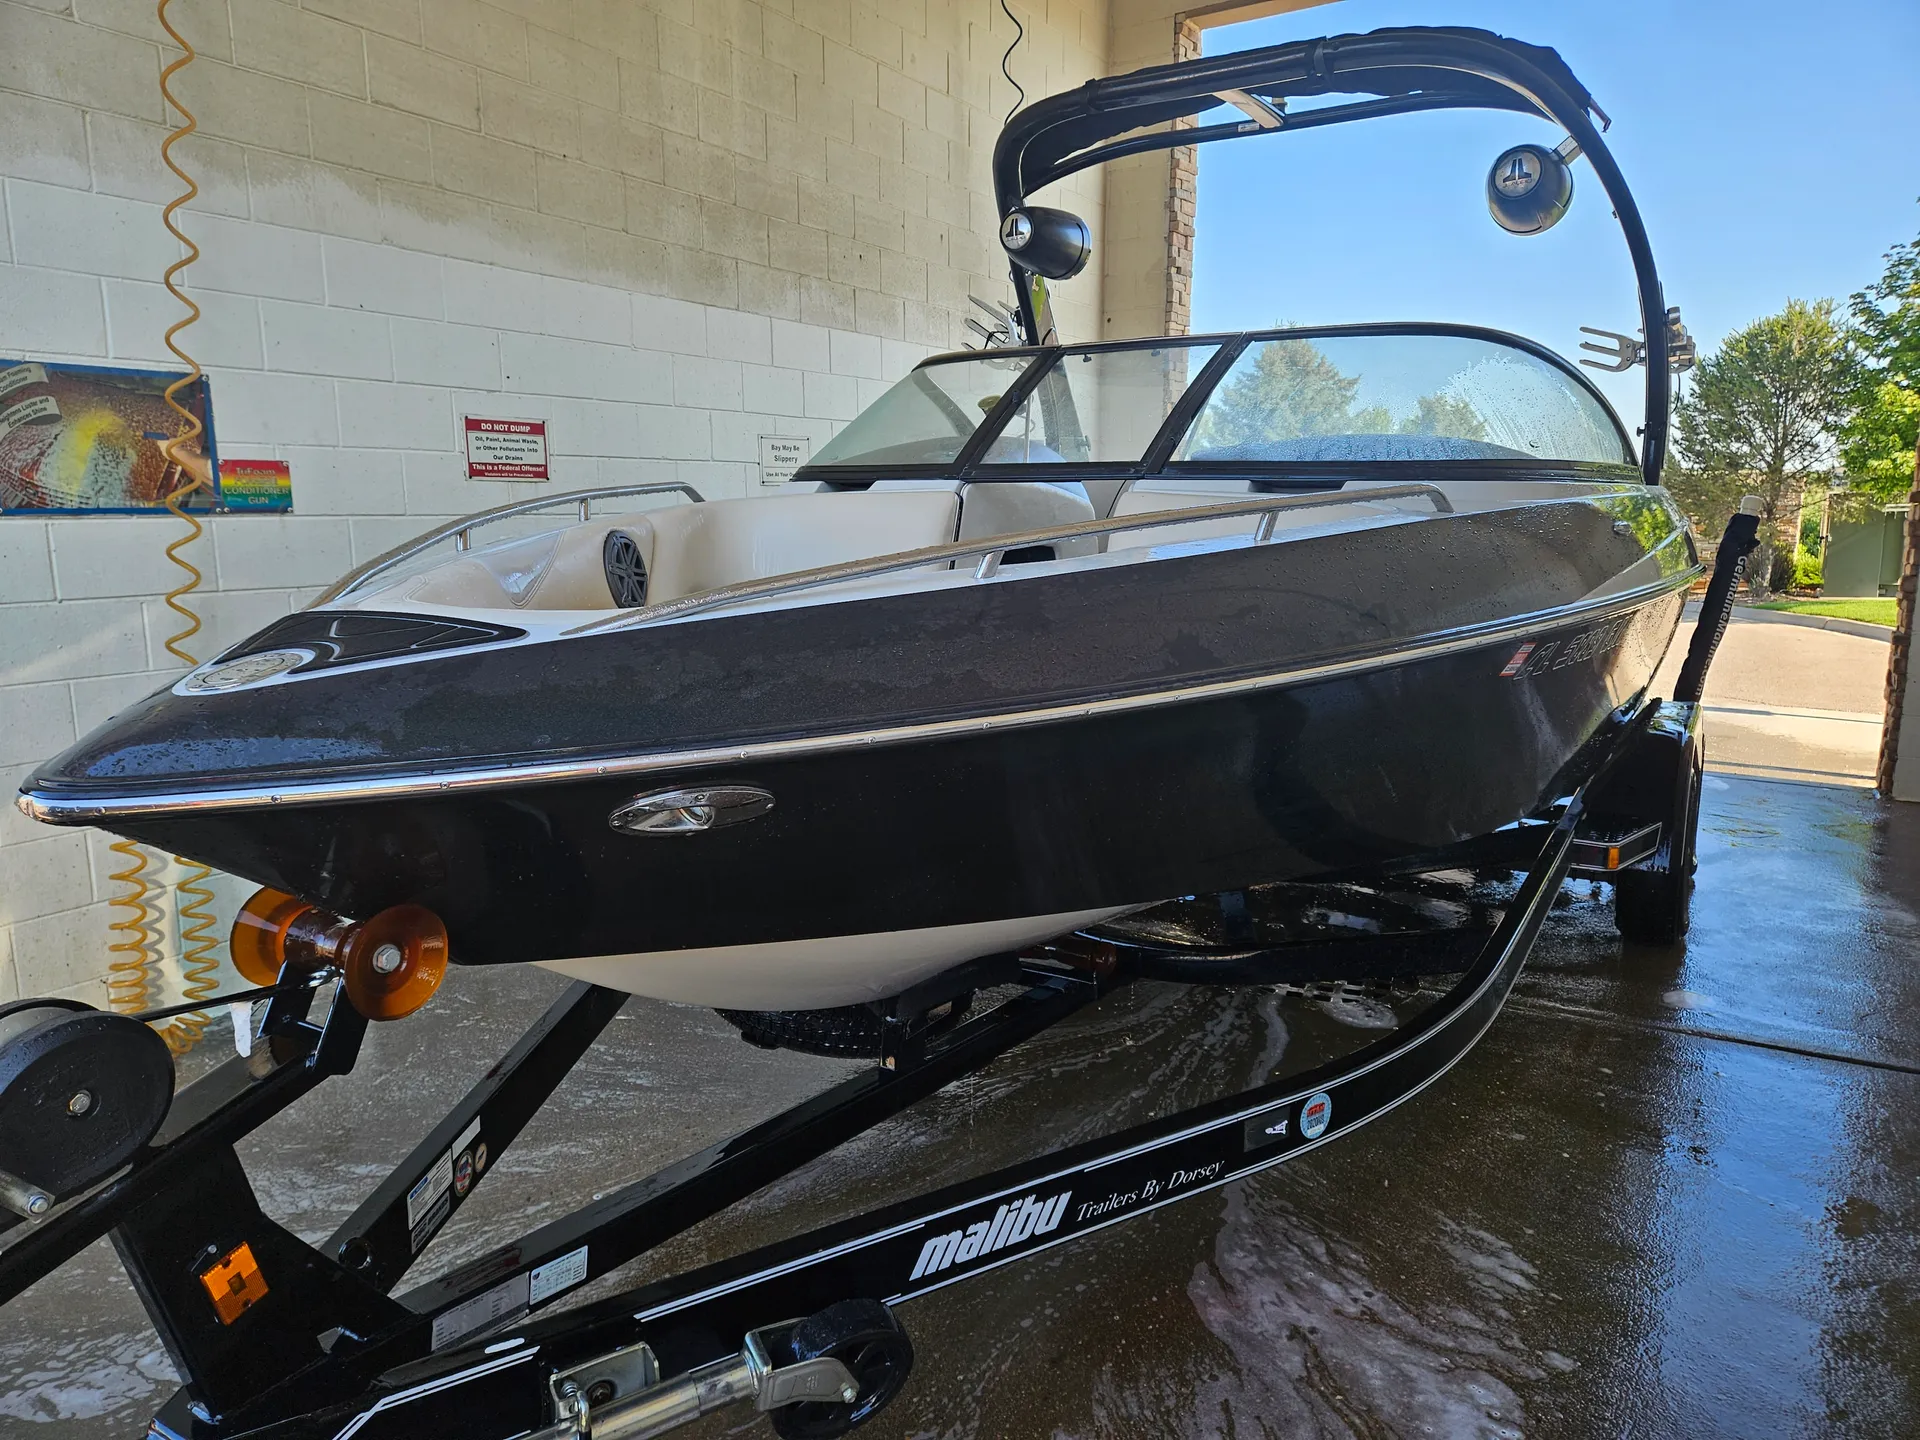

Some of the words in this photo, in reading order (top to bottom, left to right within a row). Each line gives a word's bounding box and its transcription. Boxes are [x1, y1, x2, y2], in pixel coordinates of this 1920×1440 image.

[7, 366, 31, 378] Foaming
[21, 401, 38, 411] Luster
[8, 412, 32, 429] Enhances
[31, 406, 47, 415] Shine
[493, 423, 509, 431] NOT
[510, 424, 531, 432] DUMP
[771, 444, 781, 452] Bay
[781, 444, 792, 452] May
[774, 454, 798, 463] Slippery
[224, 487, 289, 495] CONDITIONER
[248, 496, 269, 504] GUN
[909, 1191, 1073, 1281] malibu
[1076, 1190, 1139, 1222] Trailers
[1141, 1179, 1165, 1201] By
[1167, 1160, 1225, 1190] Dorsey
